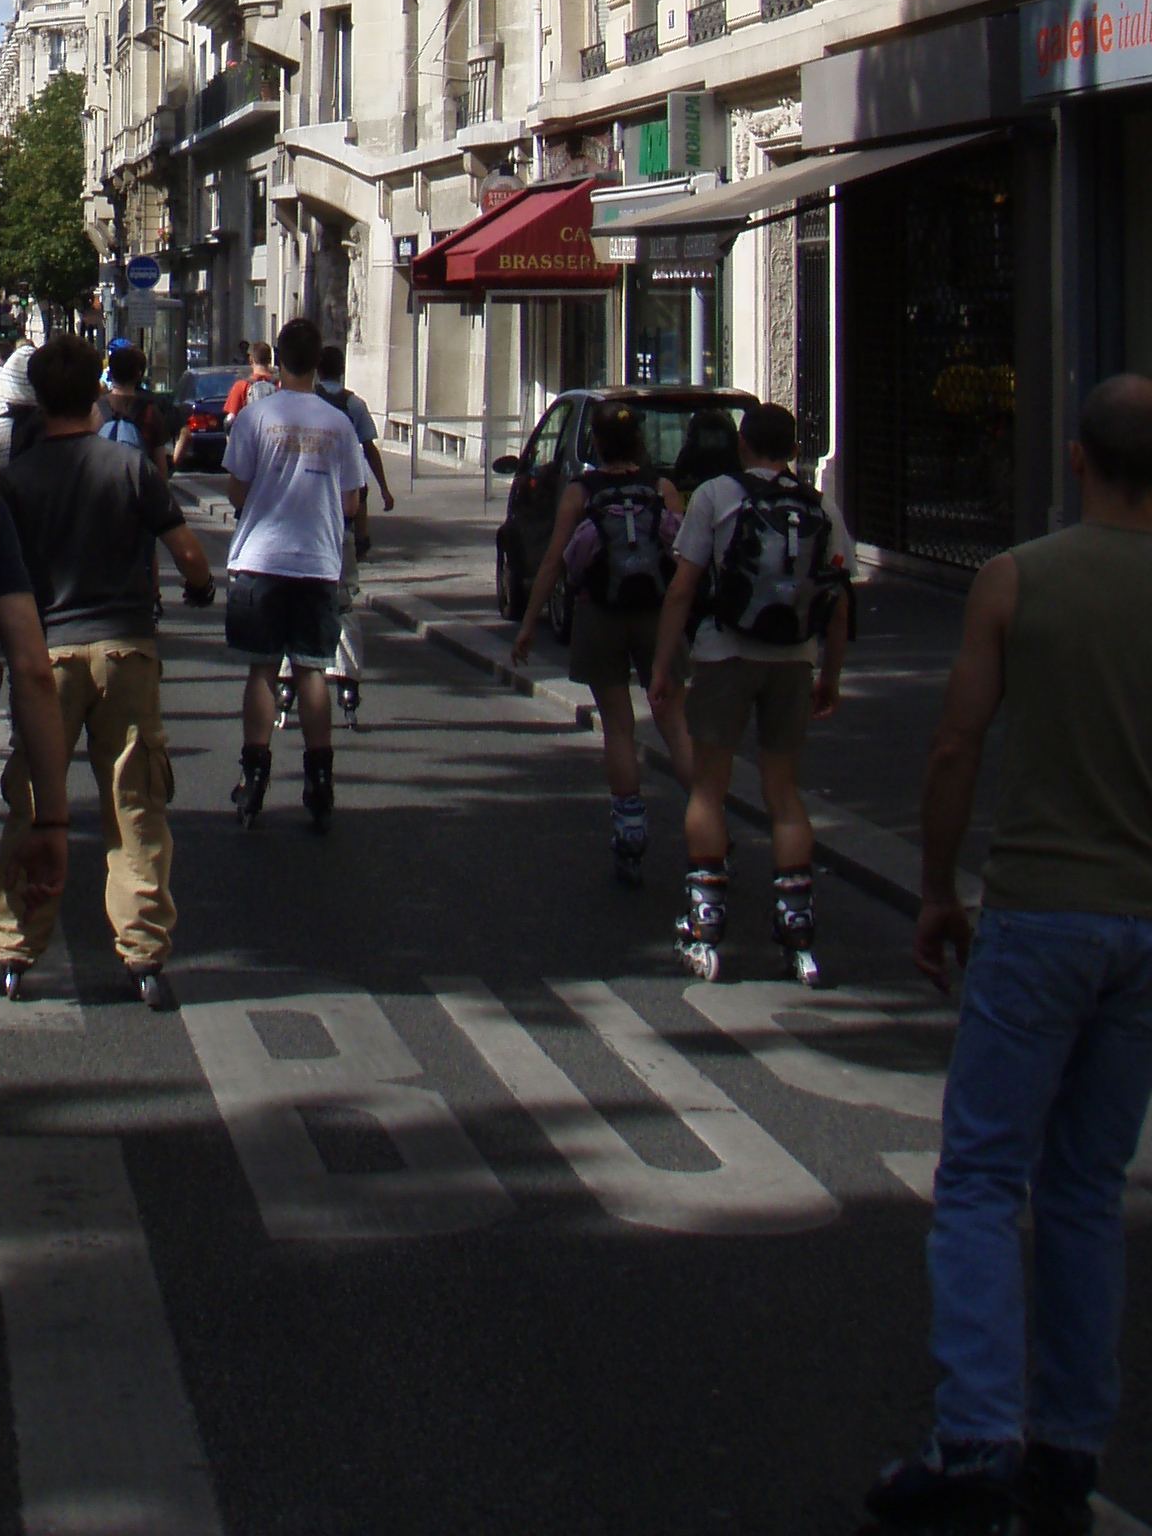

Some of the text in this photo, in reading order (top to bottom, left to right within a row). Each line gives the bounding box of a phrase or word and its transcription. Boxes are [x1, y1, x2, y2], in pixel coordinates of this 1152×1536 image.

[1037, 2, 1114, 77] galerie
[685, 95, 700, 167] MOBALPA
[170, 970, 1152, 1238] BUS
